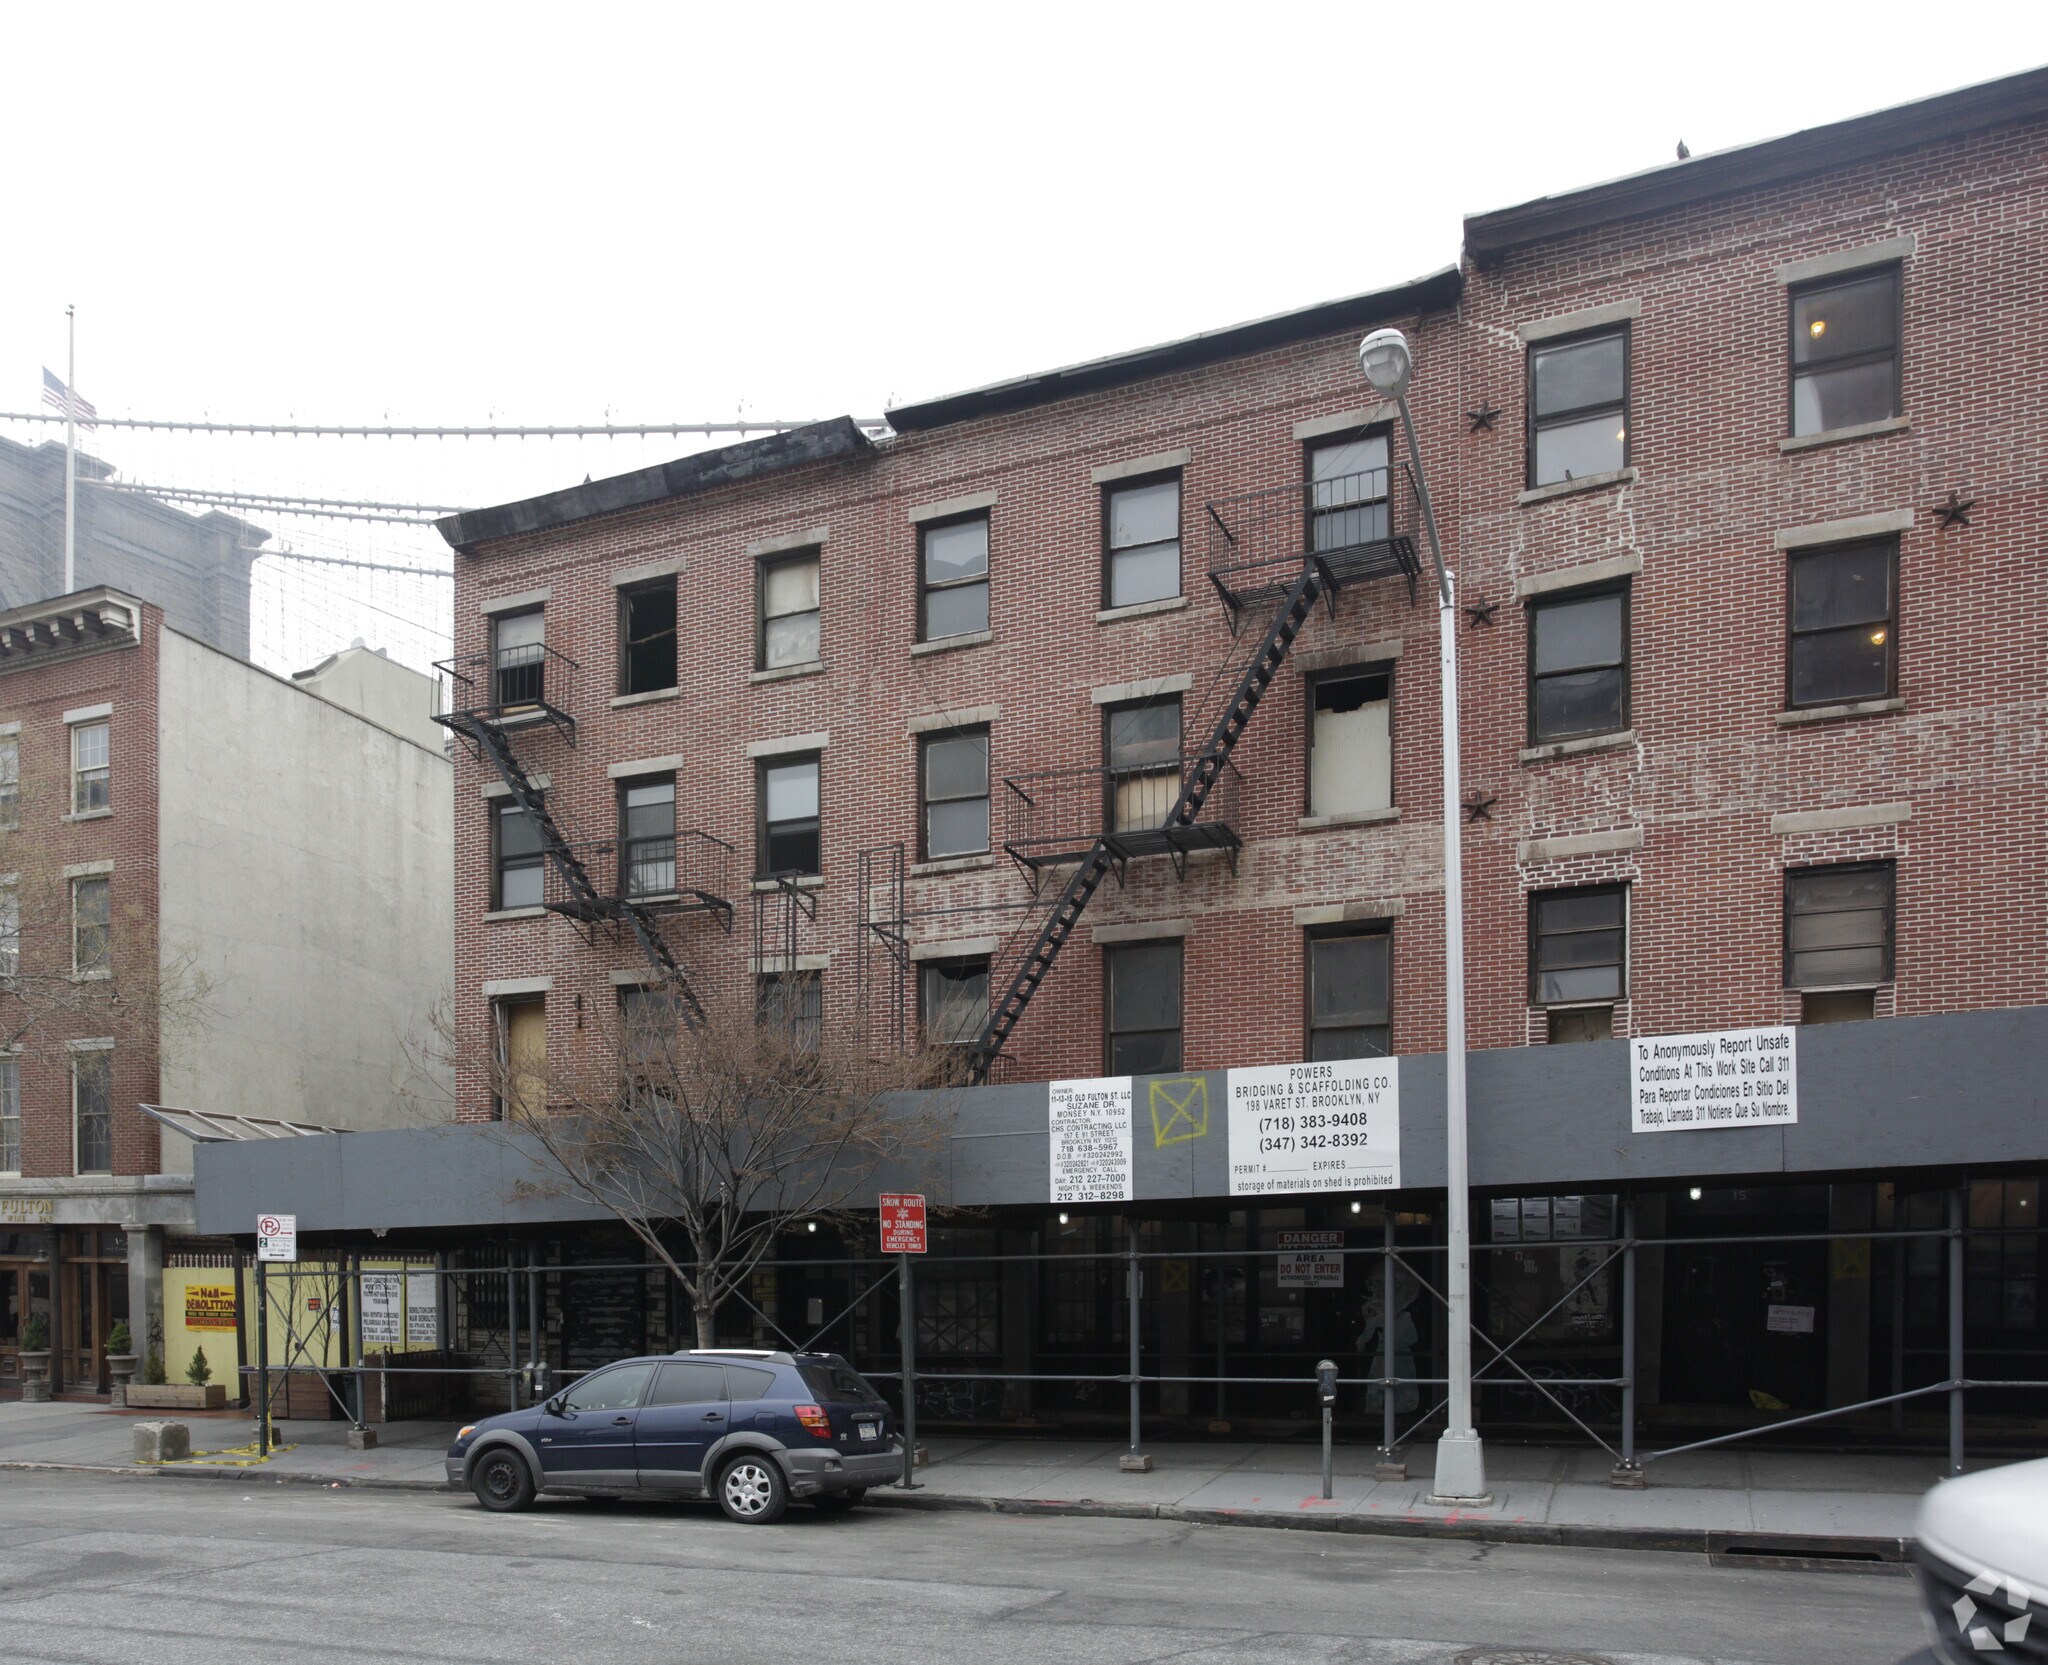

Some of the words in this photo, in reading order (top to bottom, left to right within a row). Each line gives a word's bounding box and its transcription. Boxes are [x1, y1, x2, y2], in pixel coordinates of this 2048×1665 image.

[1638, 1045, 1648, 1060] To
[1654, 1040, 1715, 1061] Anonymously
[1721, 1037, 1752, 1057] Report
[1757, 1034, 1789, 1050] Unsafe
[1291, 1066, 1332, 1079] POWERS
[1640, 1064, 1680, 1082] Conditions
[1684, 1064, 1692, 1078] At
[1697, 1062, 1712, 1077] This
[1717, 1060, 1736, 1075] Work
[1741, 1058, 1755, 1074] Site
[1760, 1057, 1774, 1073] Call
[1778, 1056, 1789, 1072] 311
[1236, 1084, 1283, 1097] BRIDGING
[1288, 1083, 1294, 1093] &
[1299, 1078, 1369, 1093] SCAFFOLDING
[1374, 1077, 1391, 1089] CO.
[1640, 1089, 1655, 1104] Para
[1660, 1087, 1690, 1105] Reportar
[1695, 1084, 1739, 1100] Condiciones
[1744, 1082, 1752, 1097] En
[1757, 1081, 1772, 1096] Sitio
[1777, 1080, 1788, 1095] Del
[1052, 1095, 1072, 1103] 11-13-15
[1121, 1091, 1130, 1099] LLC
[1247, 1102, 1260, 1111] 198
[1264, 1098, 1291, 1110] VARET
[1296, 1097, 1308, 1108] ST.
[1313, 1094, 1364, 1107] BROOKLYN,
[1368, 1092, 1380, 1103] NY
[1641, 1108, 1664, 1127] Trabajo,
[1667, 1106, 1693, 1122] Llamada
[1696, 1105, 1705, 1120] 311
[1708, 1104, 1731, 1120] Notiene
[1735, 1103, 1747, 1118] Que
[1752, 1102, 1759, 1117] Su
[1763, 1101, 1790, 1116] Nombre.
[1067, 1123, 1112, 1131] CONTRACTING
[1259, 1117, 1295, 1134] (718)
[1301, 1113, 1367, 1128] 383-9408
[1259, 1137, 1295, 1154] (347)
[1301, 1133, 1367, 1149] 342-8392
[1235, 1165, 1260, 1174] PERMIT
[1262, 1164, 1267, 1172] #
[1313, 1161, 1346, 1170] EXPIRES
[1087, 1174, 1125, 1182] 227-7000
[1238, 1180, 1264, 1193] storage
[1267, 1179, 1274, 1189] of
[1277, 1178, 1310, 1189] materials
[1313, 1178, 1322, 1187] on
[1325, 1177, 1342, 1187] shed
[1345, 1176, 1351, 1186] is
[1354, 1174, 1392, 1188] prohibited
[1079, 1191, 1124, 1200] 312-8298
[1733, 1191, 1746, 1200] 15
[2, 1200, 53, 1213] FULTON
[883, 1198, 899, 1206] SNOW
[904, 1198, 923, 1207] ROUTE
[895, 1221, 923, 1229] STANDING
[261, 1239, 266, 1247] 2
[1284, 1234, 1337, 1243] DANGER
[1281, 1264, 1291, 1274] DO
[1295, 1264, 1311, 1274] NOT
[1315, 1264, 1340, 1274] ENTER
[187, 1300, 236, 1310] DEMOLITION
